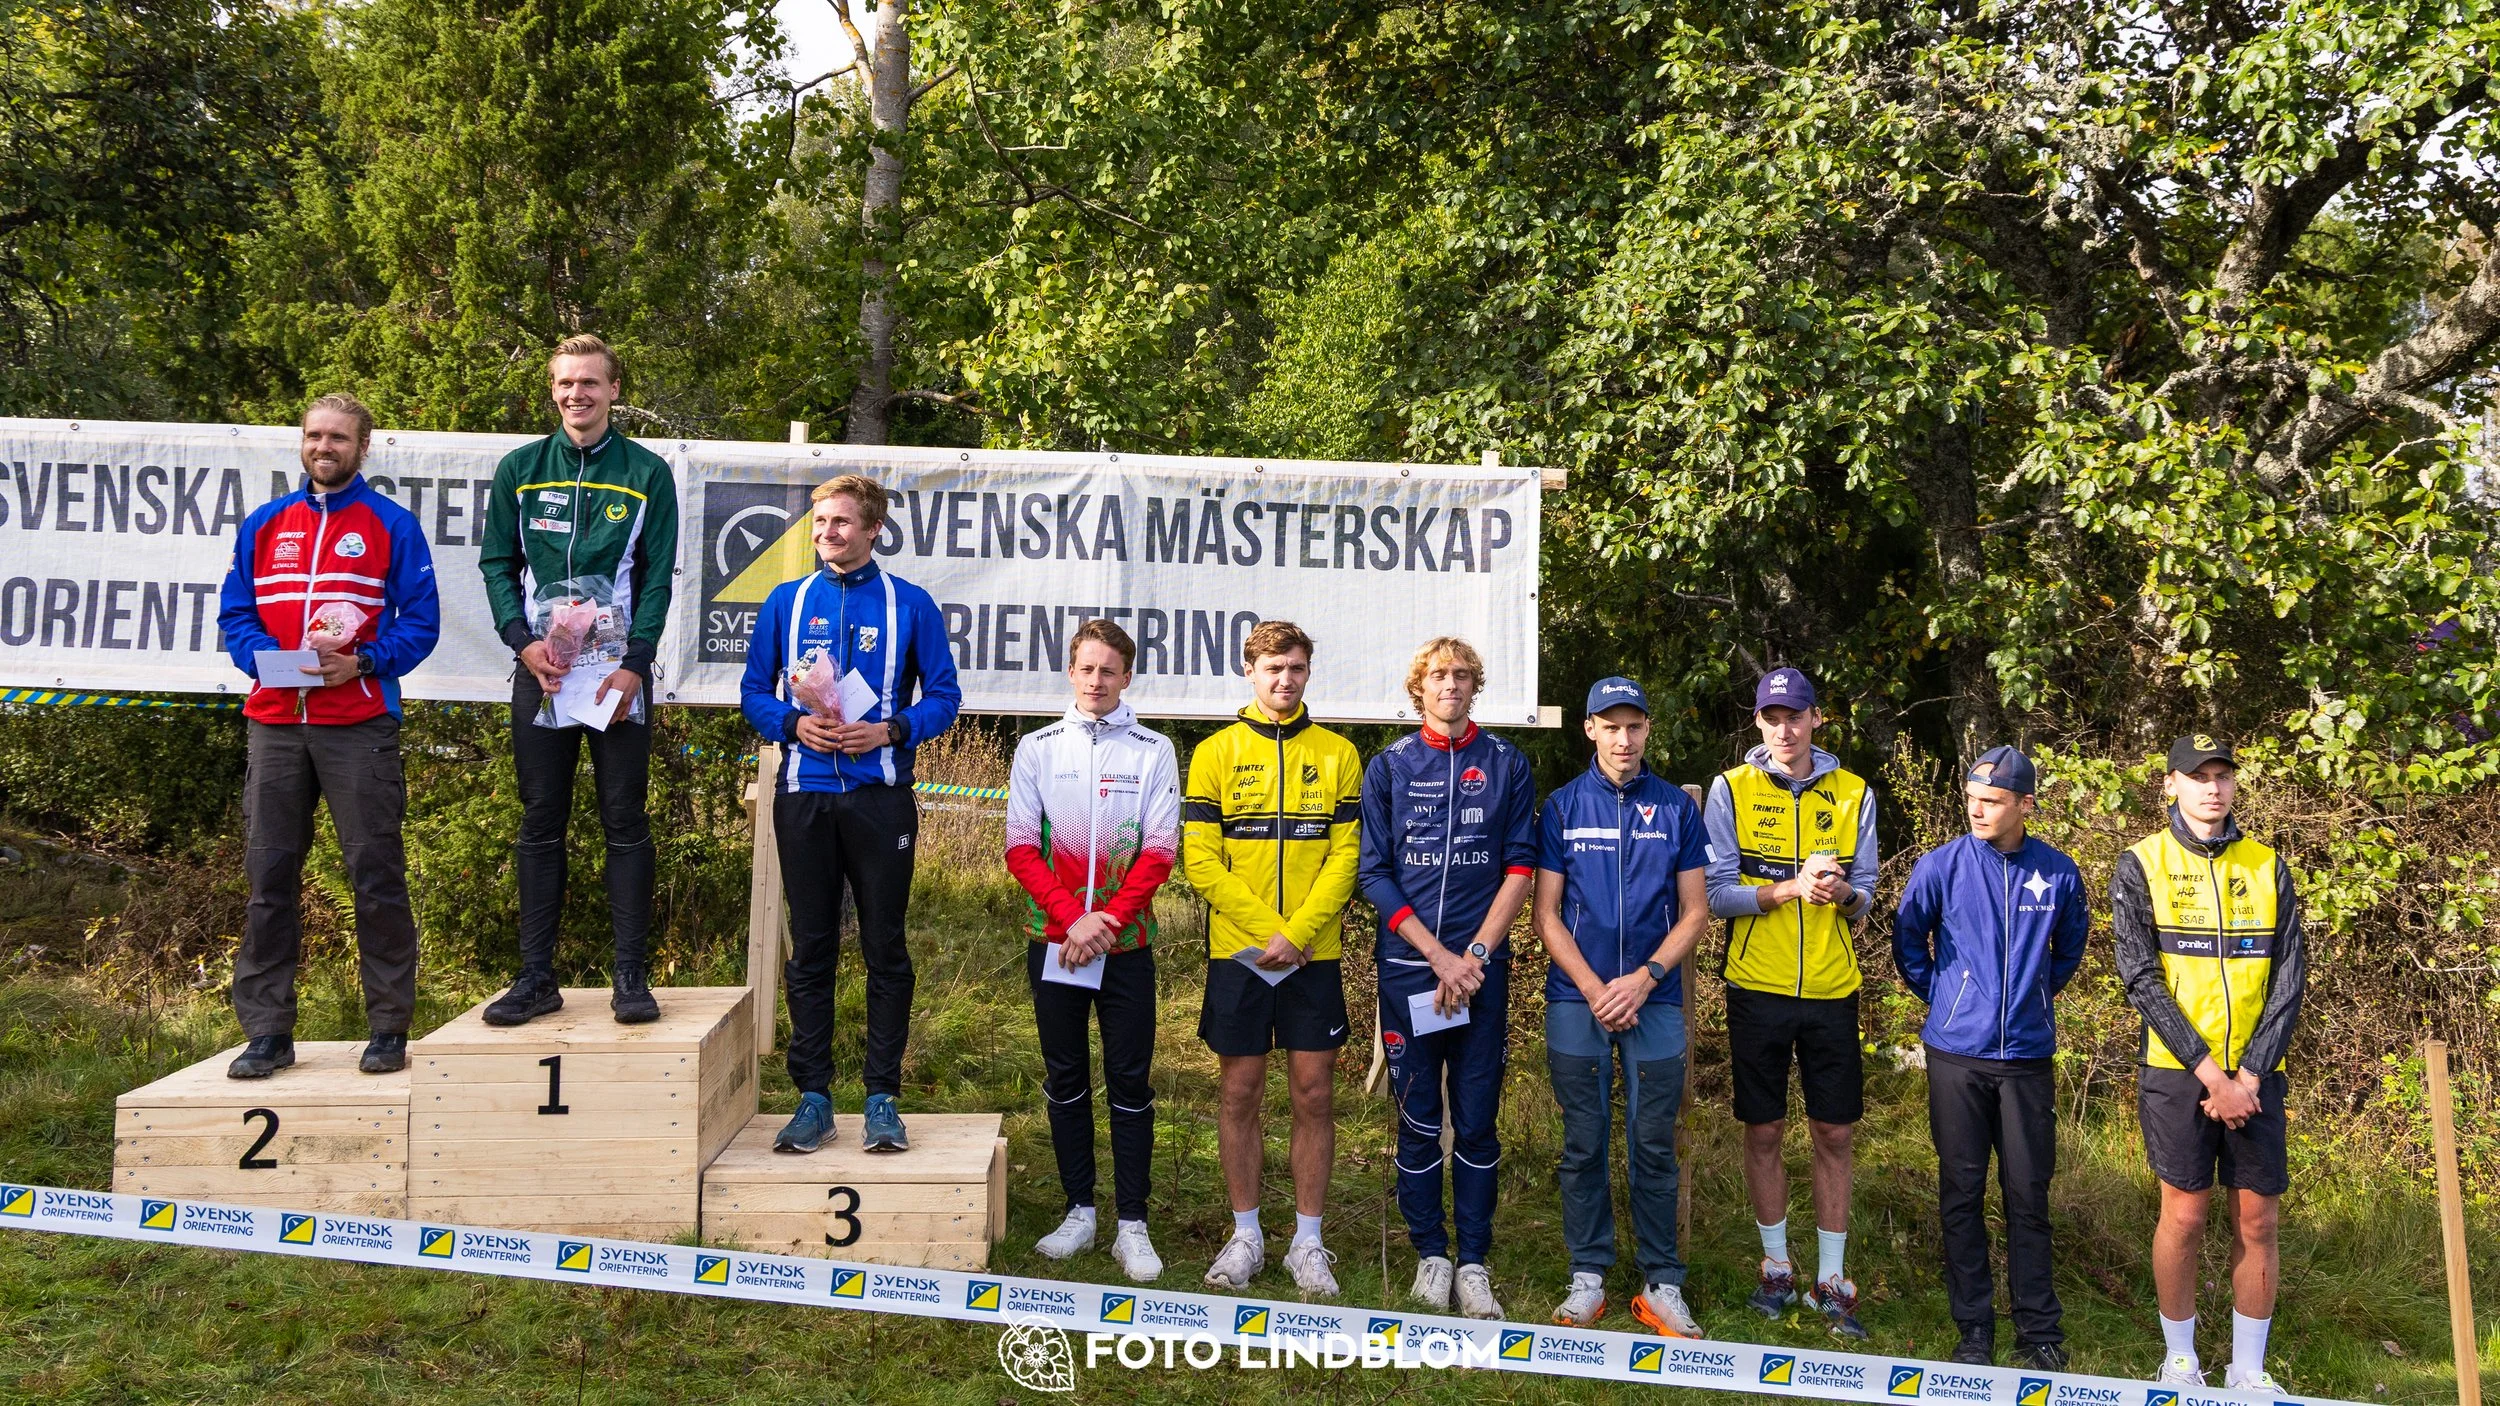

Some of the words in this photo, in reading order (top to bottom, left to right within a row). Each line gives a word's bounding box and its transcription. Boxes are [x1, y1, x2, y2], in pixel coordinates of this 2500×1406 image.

[872, 488, 1128, 562] SVENSKA
[1145, 487, 1513, 573] MÄSTERSKAP
[0, 576, 229, 653] ORIENT
[708, 610, 758, 634] SVE
[706, 638, 751, 653] ORIEN
[1036, 727, 1065, 742] TRIMTEX
[1127, 730, 1159, 745] TRIMTEX
[1233, 764, 1265, 773] TRIMTEX
[1301, 790, 1323, 799] viati
[1300, 803, 1323, 812] SSAB
[1753, 804, 1786, 814] TRIMTEX
[1631, 829, 1667, 840] Hagaby
[1815, 836, 1837, 846] viati
[1588, 844, 1616, 852] Moelven
[1758, 843, 1782, 854] SSAB
[2168, 874, 2204, 882] TRIMTEX
[2230, 905, 2255, 915] viati
[2178, 914, 2205, 925] SSAB
[538, 1055, 569, 1115] 1
[239, 1108, 280, 1170] 2
[44, 1191, 113, 1210] SVENSK
[41, 1207, 113, 1223] ORIENTERING
[185, 1205, 254, 1224] SVENSK
[825, 1186, 862, 1247] 3
[182, 1220, 254, 1236] ORIENTERING
[324, 1219, 393, 1238] SVENSK
[322, 1234, 393, 1251] ORIENTERING
[463, 1232, 531, 1252] SVENSK
[461, 1248, 531, 1264] ORIENTERING
[600, 1246, 669, 1265] SVENSK
[598, 1262, 668, 1278] ORIENTERING
[737, 1260, 805, 1279] SVENSK
[736, 1275, 805, 1290] ORIENTERING
[873, 1274, 941, 1292] SVENSK
[871, 1288, 940, 1304] ORIENTERING
[1008, 1286, 1075, 1304] SVENSK
[1007, 1301, 1075, 1316] ORIENTERING
[1142, 1299, 1209, 1317] SVENSK
[1141, 1313, 1208, 1329] ORIENTERING
[1276, 1312, 1342, 1330] SVENSK
[1540, 1336, 1607, 1354] SVENSK
[1538, 1350, 1605, 1366] ORIENTERING
[1670, 1349, 1736, 1367] SVENSK
[1668, 1363, 1735, 1378] ORIENTERING
[1800, 1361, 1866, 1379] SVENSK
[1798, 1375, 1864, 1390] ORIENTERING
[1929, 1373, 1994, 1391] SVENSK
[1926, 1387, 1992, 1402] ORIENTERING
[2057, 1385, 2122, 1403] SVENSK
